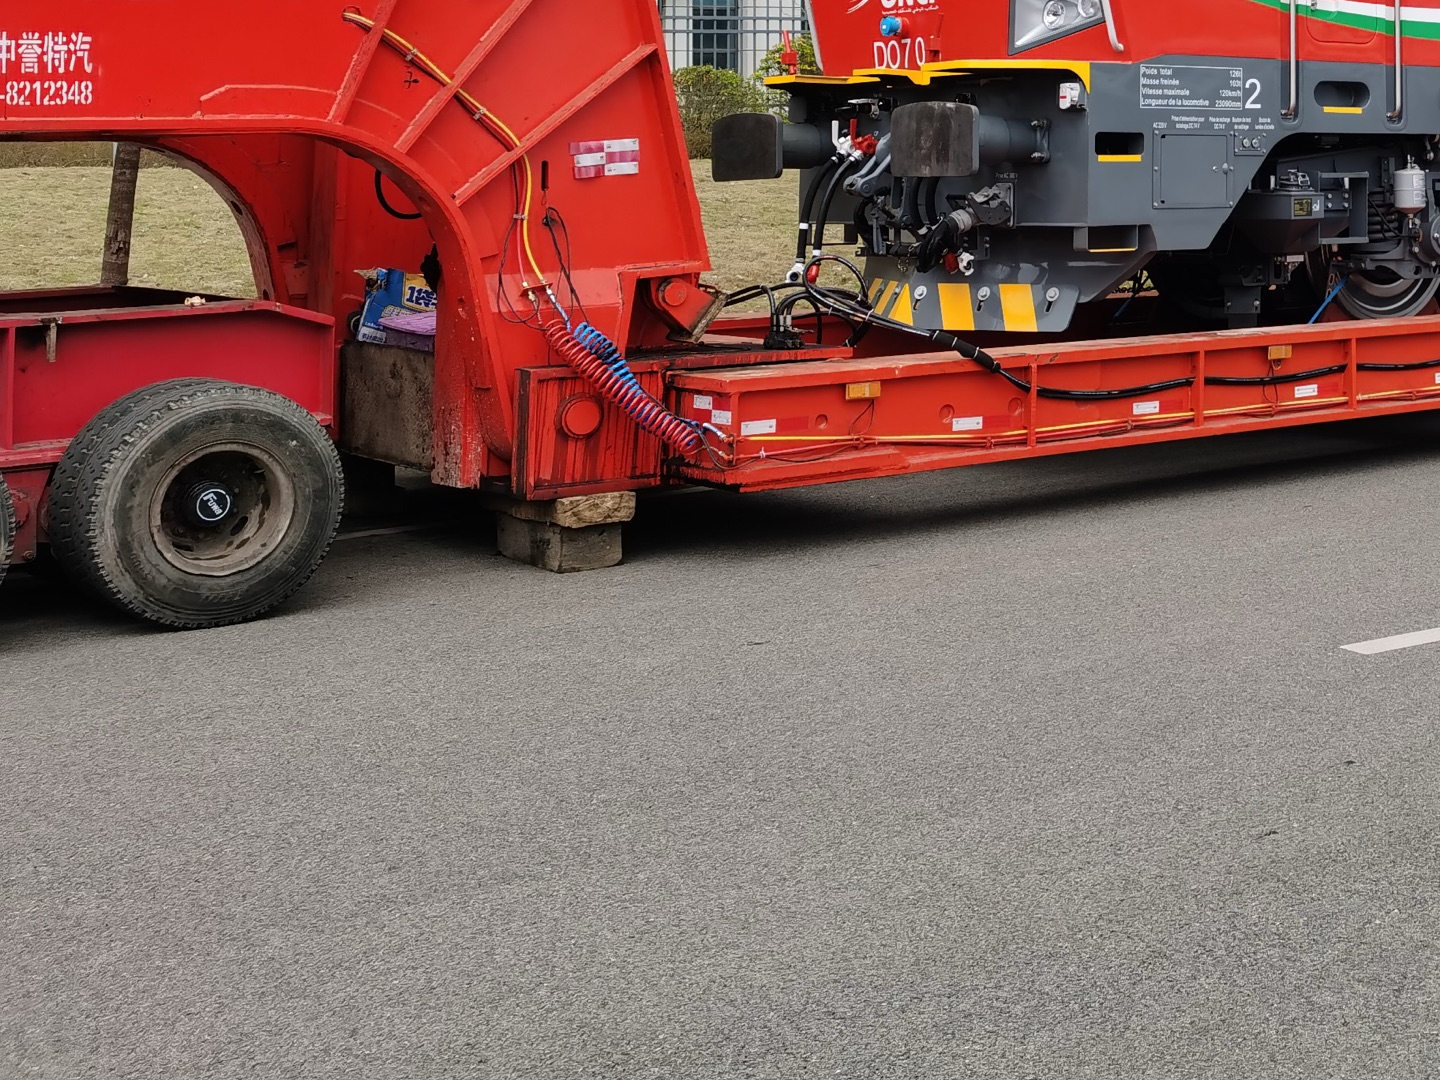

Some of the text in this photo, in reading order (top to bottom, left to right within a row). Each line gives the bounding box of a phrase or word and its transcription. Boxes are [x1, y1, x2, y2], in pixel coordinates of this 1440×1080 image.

[0, 31, 93, 74] 中誉特汽
[873, 36, 941, 70] DO70
[1159, 68, 1173, 76] total
[1244, 78, 1262, 109] 2
